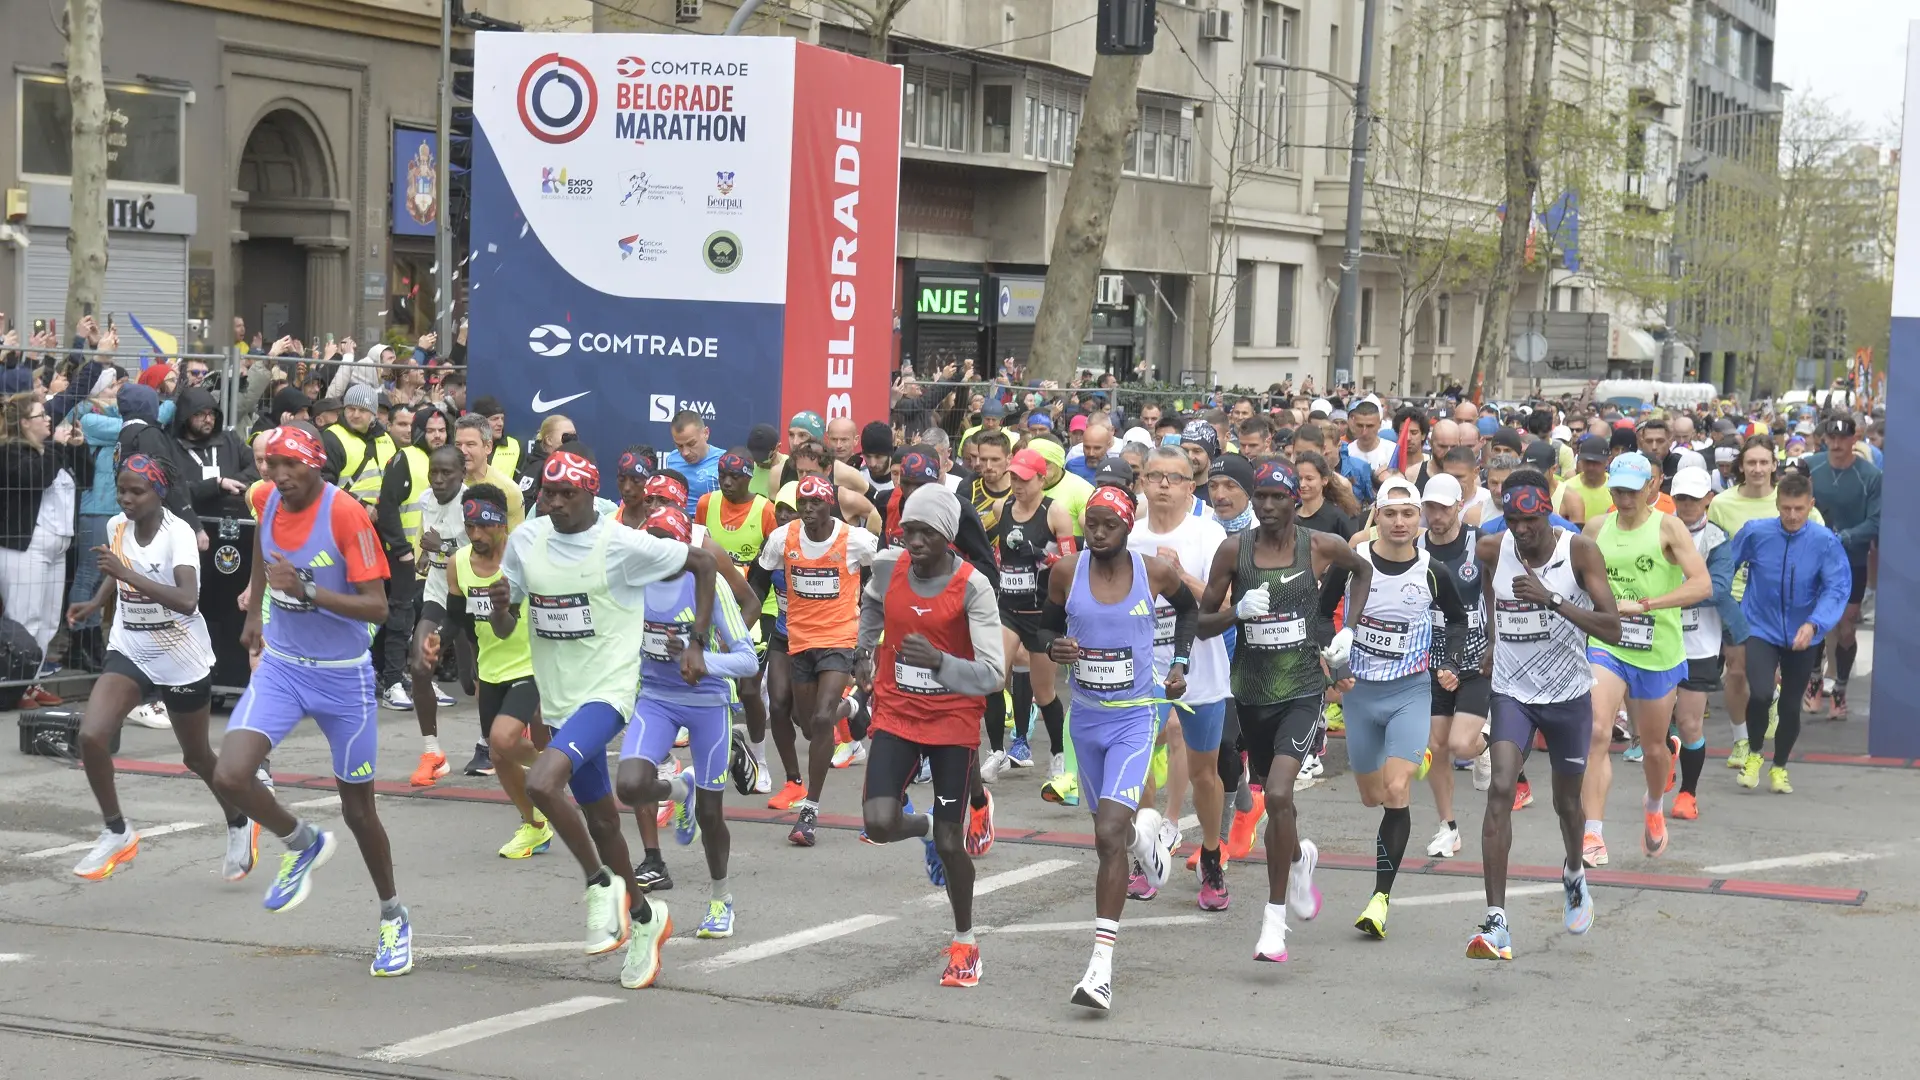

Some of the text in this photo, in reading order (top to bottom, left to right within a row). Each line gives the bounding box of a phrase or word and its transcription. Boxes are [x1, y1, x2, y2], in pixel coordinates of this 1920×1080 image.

[651, 61, 748, 76] COMTRADE
[617, 83, 733, 112] BELGRADE
[616, 112, 746, 142] MARATHON
[567, 179, 593, 187] EXPO
[567, 187, 593, 195] 2027
[707, 195, 742, 210] Београд
[826, 108, 862, 432] BELGRADE
[917, 288, 968, 314] NJE
[578, 332, 719, 358] COMTRADE
[679, 400, 716, 415] SAVA
[546, 613, 569, 621] MAGUT
[1262, 627, 1290, 635] JACKSON
[1365, 631, 1392, 647] 1928
[1087, 665, 1115, 674] MATHEW
